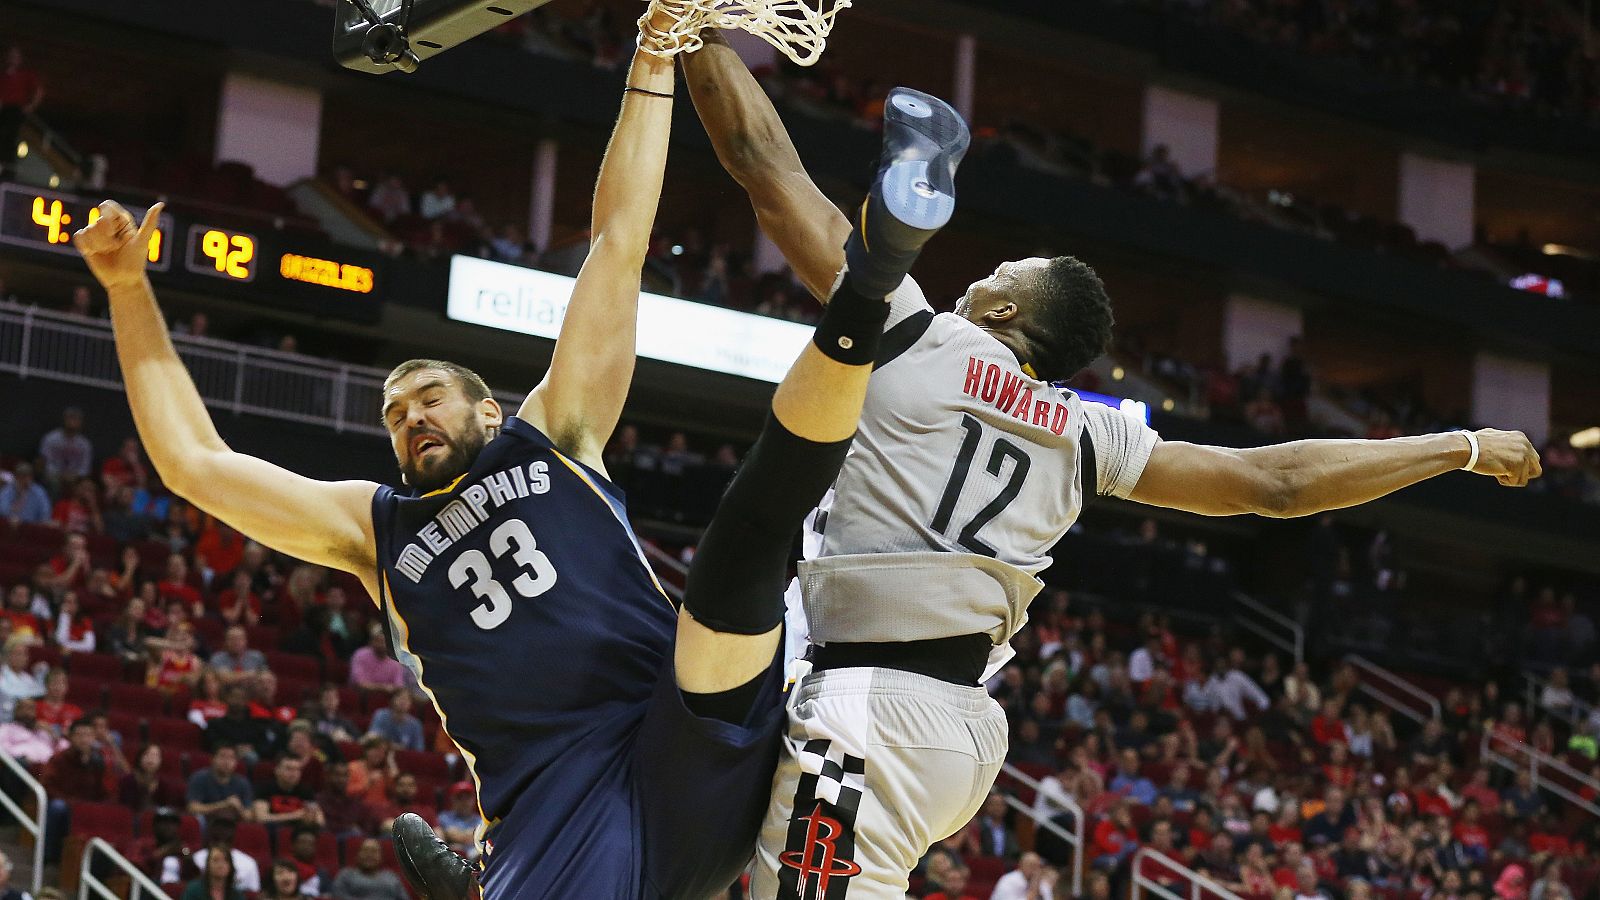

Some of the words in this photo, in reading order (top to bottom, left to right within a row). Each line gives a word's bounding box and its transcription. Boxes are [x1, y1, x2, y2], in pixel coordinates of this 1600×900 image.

[202, 230, 254, 280] 92
[963, 356, 1069, 436] HOWARD
[395, 460, 551, 584] MEMPHIS
[930, 413, 1032, 559] 12
[447, 518, 558, 630] 33
